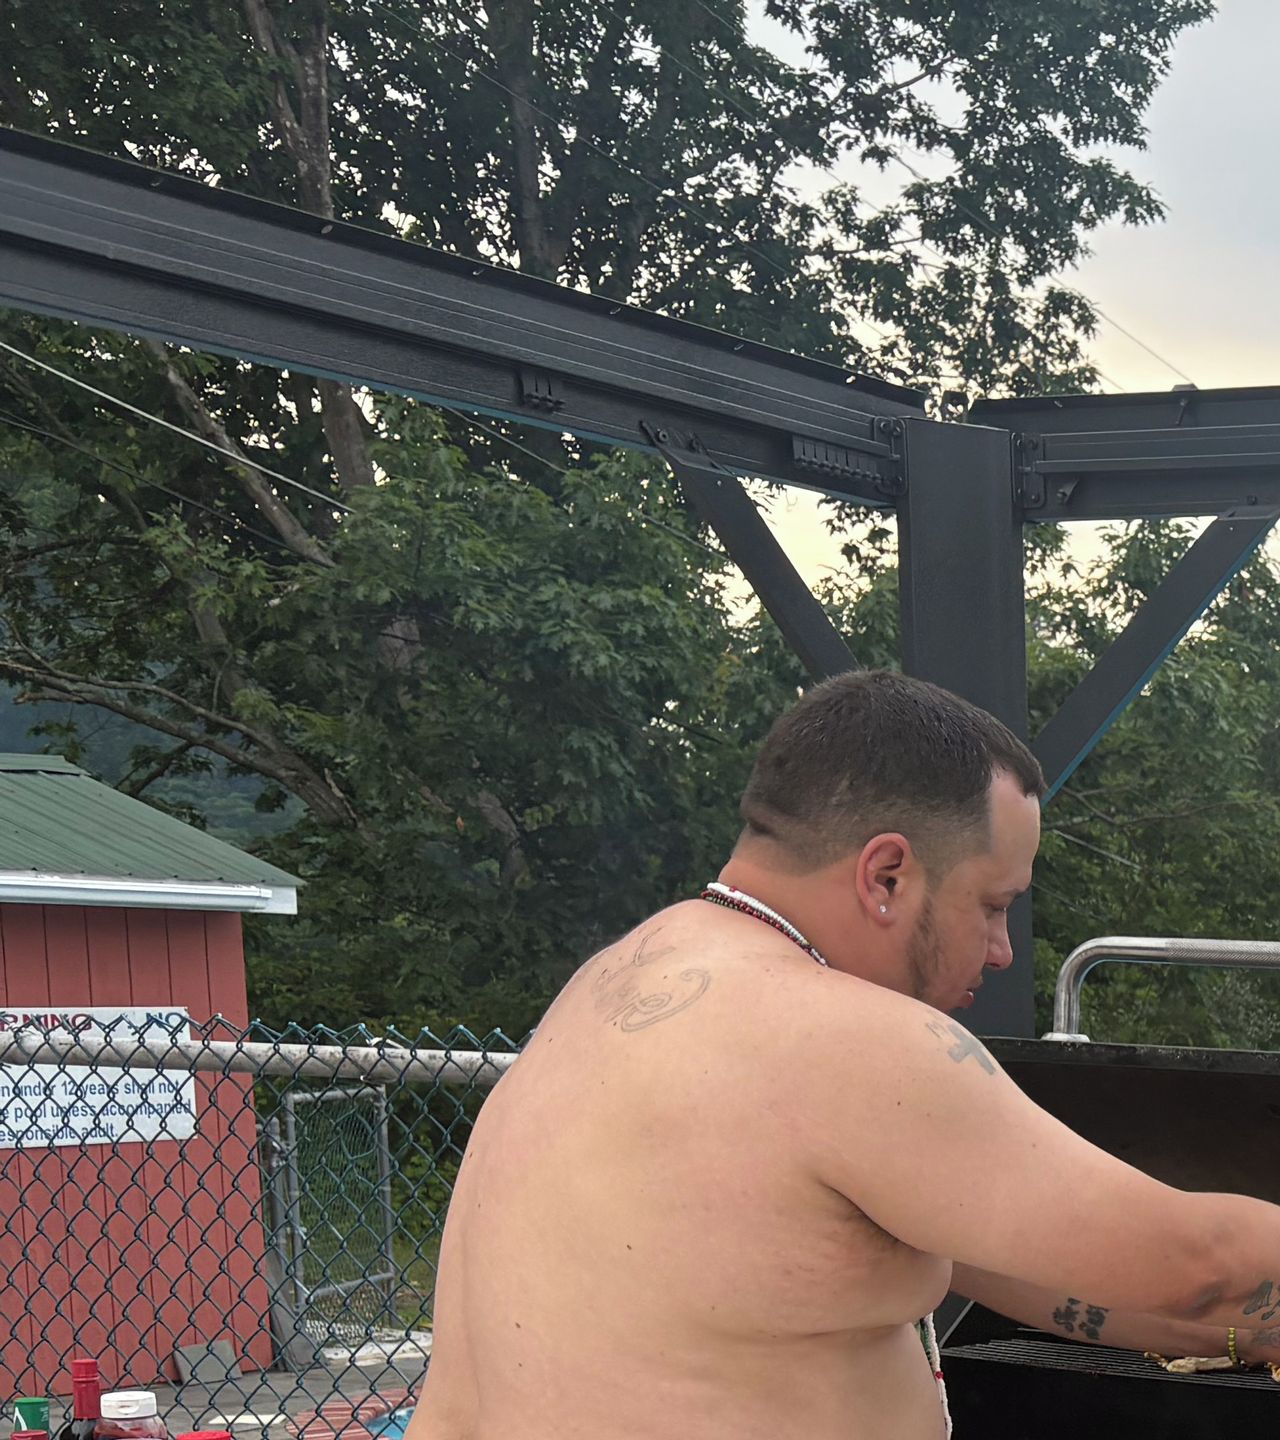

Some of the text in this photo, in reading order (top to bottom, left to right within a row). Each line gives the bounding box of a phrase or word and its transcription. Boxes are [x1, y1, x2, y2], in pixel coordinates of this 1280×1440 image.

[62, 1080, 75, 1096] 12
[158, 1080, 179, 1094] not
[14, 1102, 46, 1123] pool
[101, 1098, 191, 1119] accompanied
